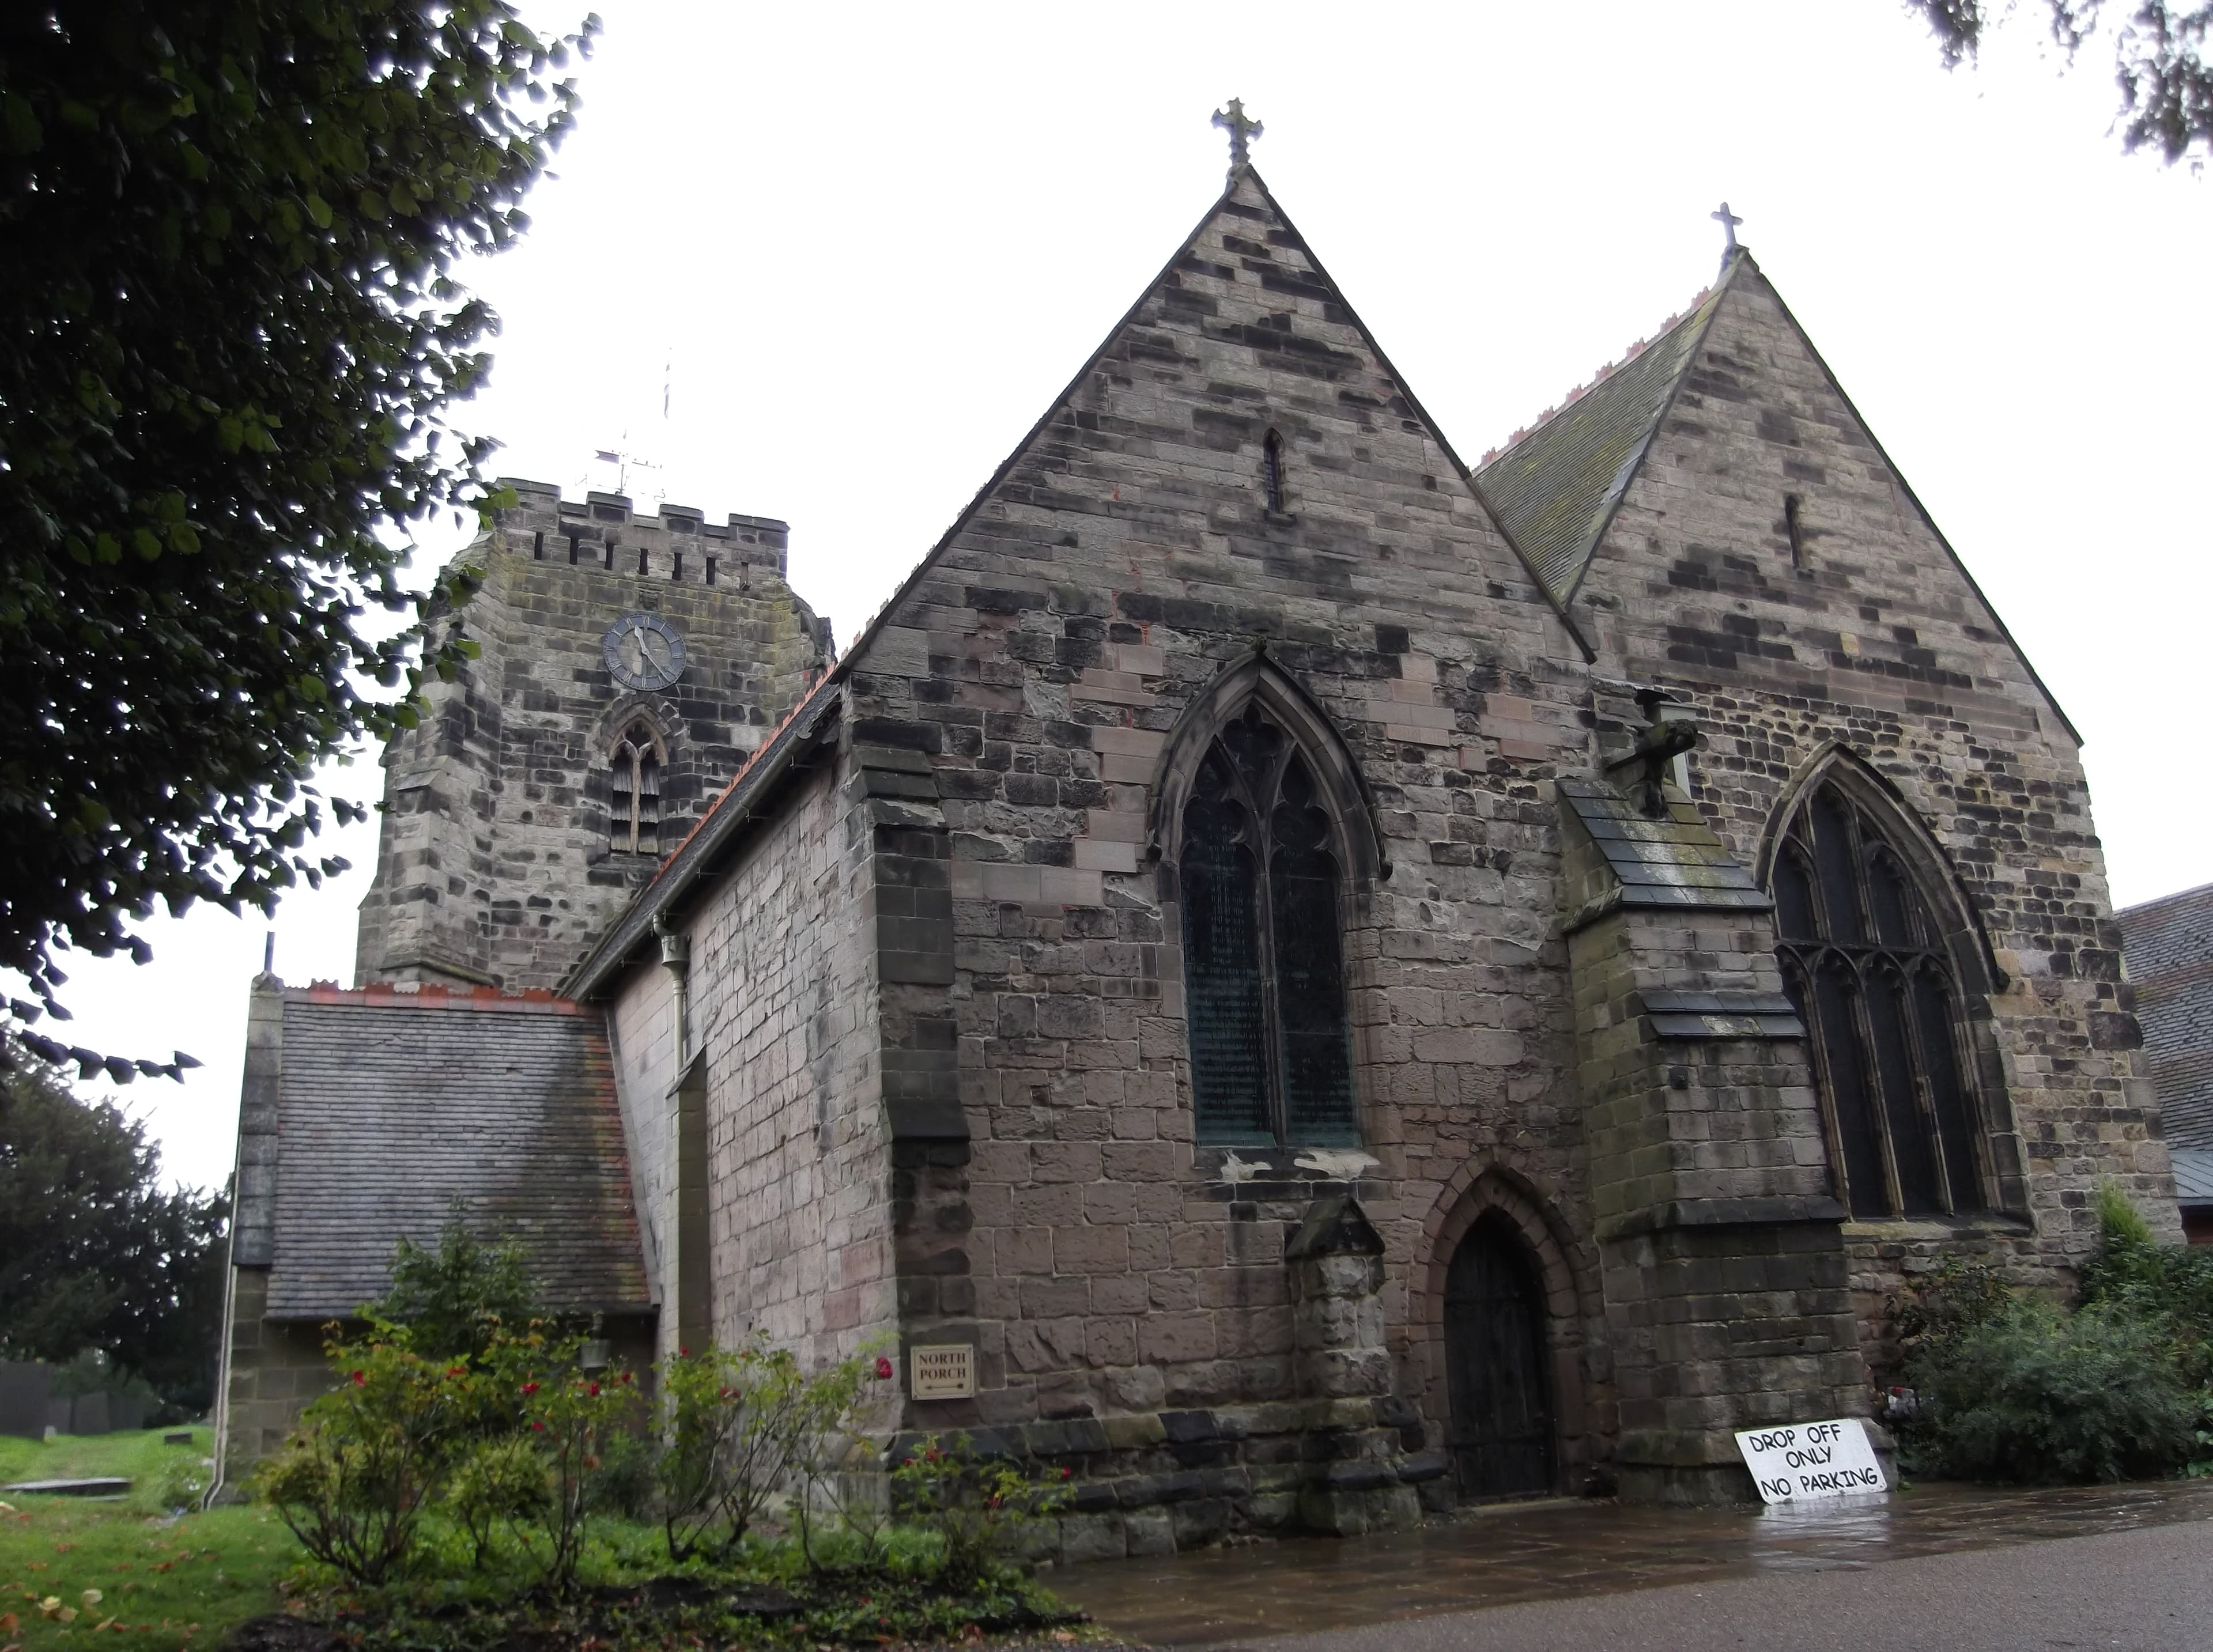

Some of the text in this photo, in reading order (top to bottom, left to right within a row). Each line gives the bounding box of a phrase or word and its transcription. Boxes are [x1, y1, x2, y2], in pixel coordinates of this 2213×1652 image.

[919, 1353, 966, 1366] NORTH
[920, 1367, 966, 1380] PORCH
[1749, 1424, 1841, 1452] DROP OFF
[1786, 1446, 1831, 1468] ONLY
[1761, 1467, 1878, 1497] NO PARKING
